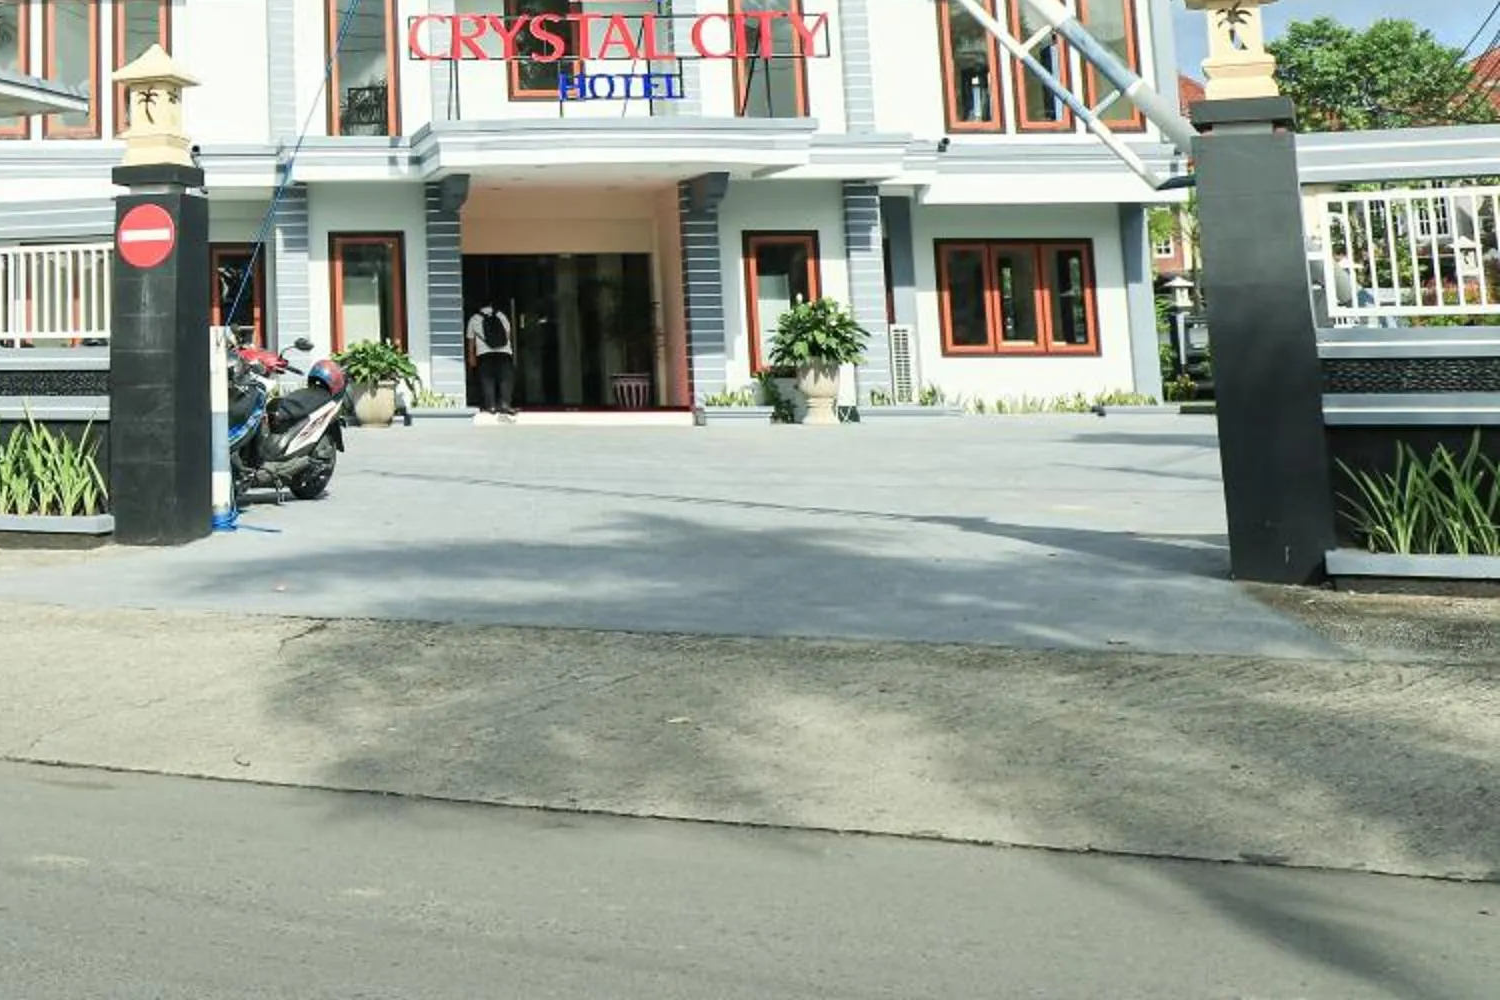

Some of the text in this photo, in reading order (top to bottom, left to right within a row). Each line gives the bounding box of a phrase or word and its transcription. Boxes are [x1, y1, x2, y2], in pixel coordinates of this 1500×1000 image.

[409, 11, 829, 61] CRYSTAL CITY
[559, 72, 684, 101] HOTEL
